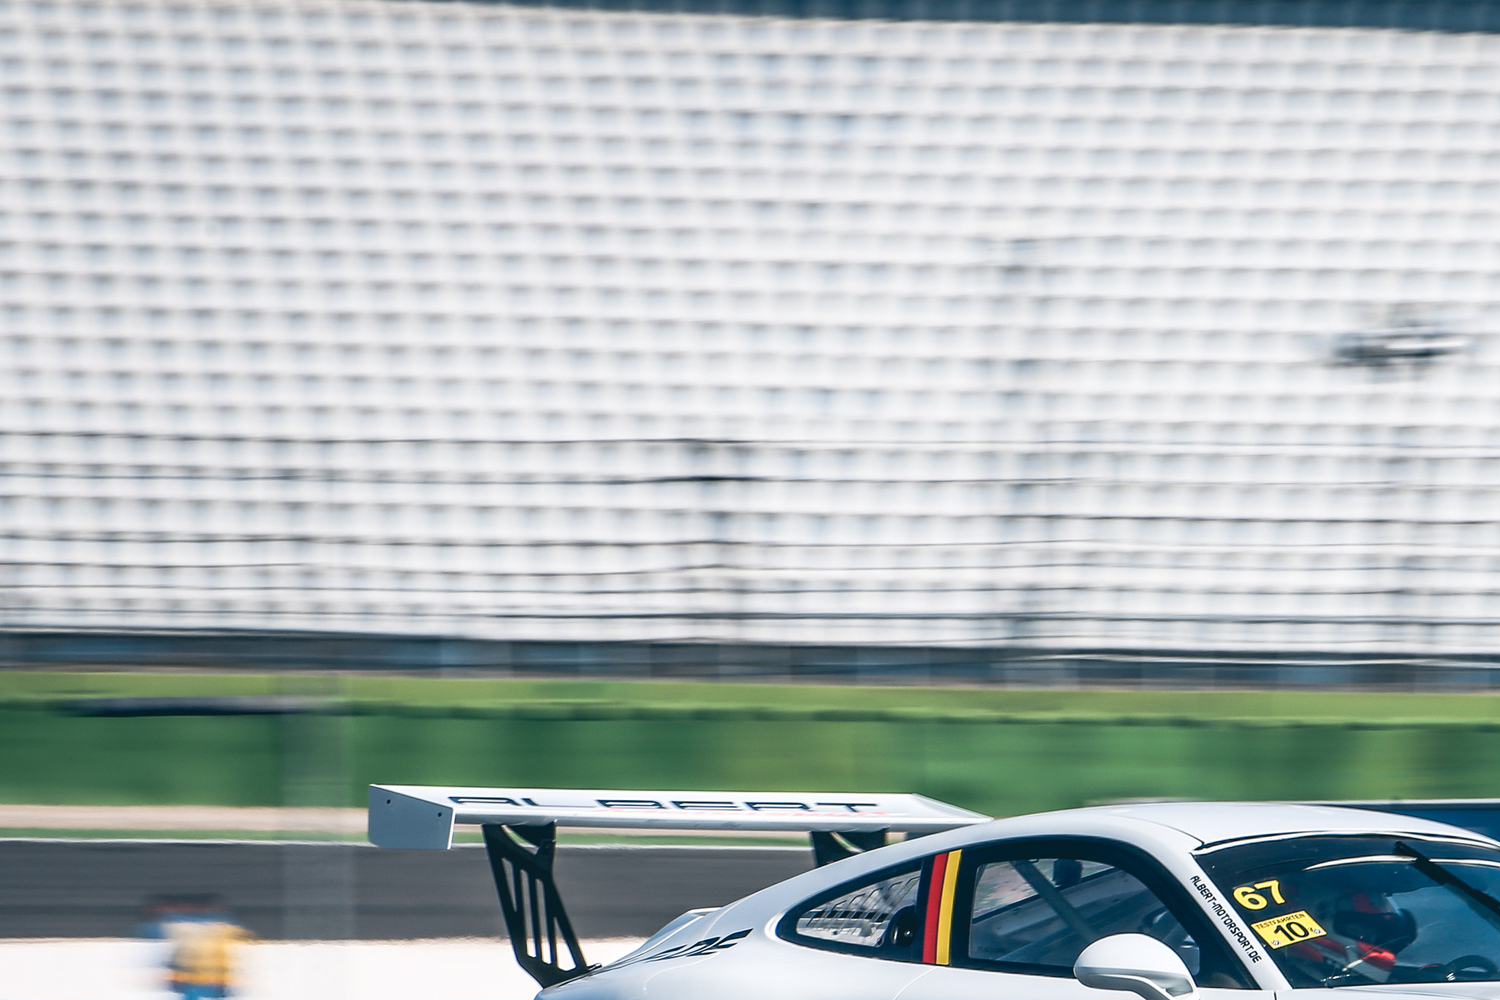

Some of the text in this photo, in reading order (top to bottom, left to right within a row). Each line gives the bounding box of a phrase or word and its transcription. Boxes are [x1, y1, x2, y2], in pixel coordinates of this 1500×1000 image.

[1233, 880, 1286, 910] 67
[1190, 875, 1263, 964] ALBERT-MOTORSPORT.DE
[1273, 921, 1309, 942] 10
